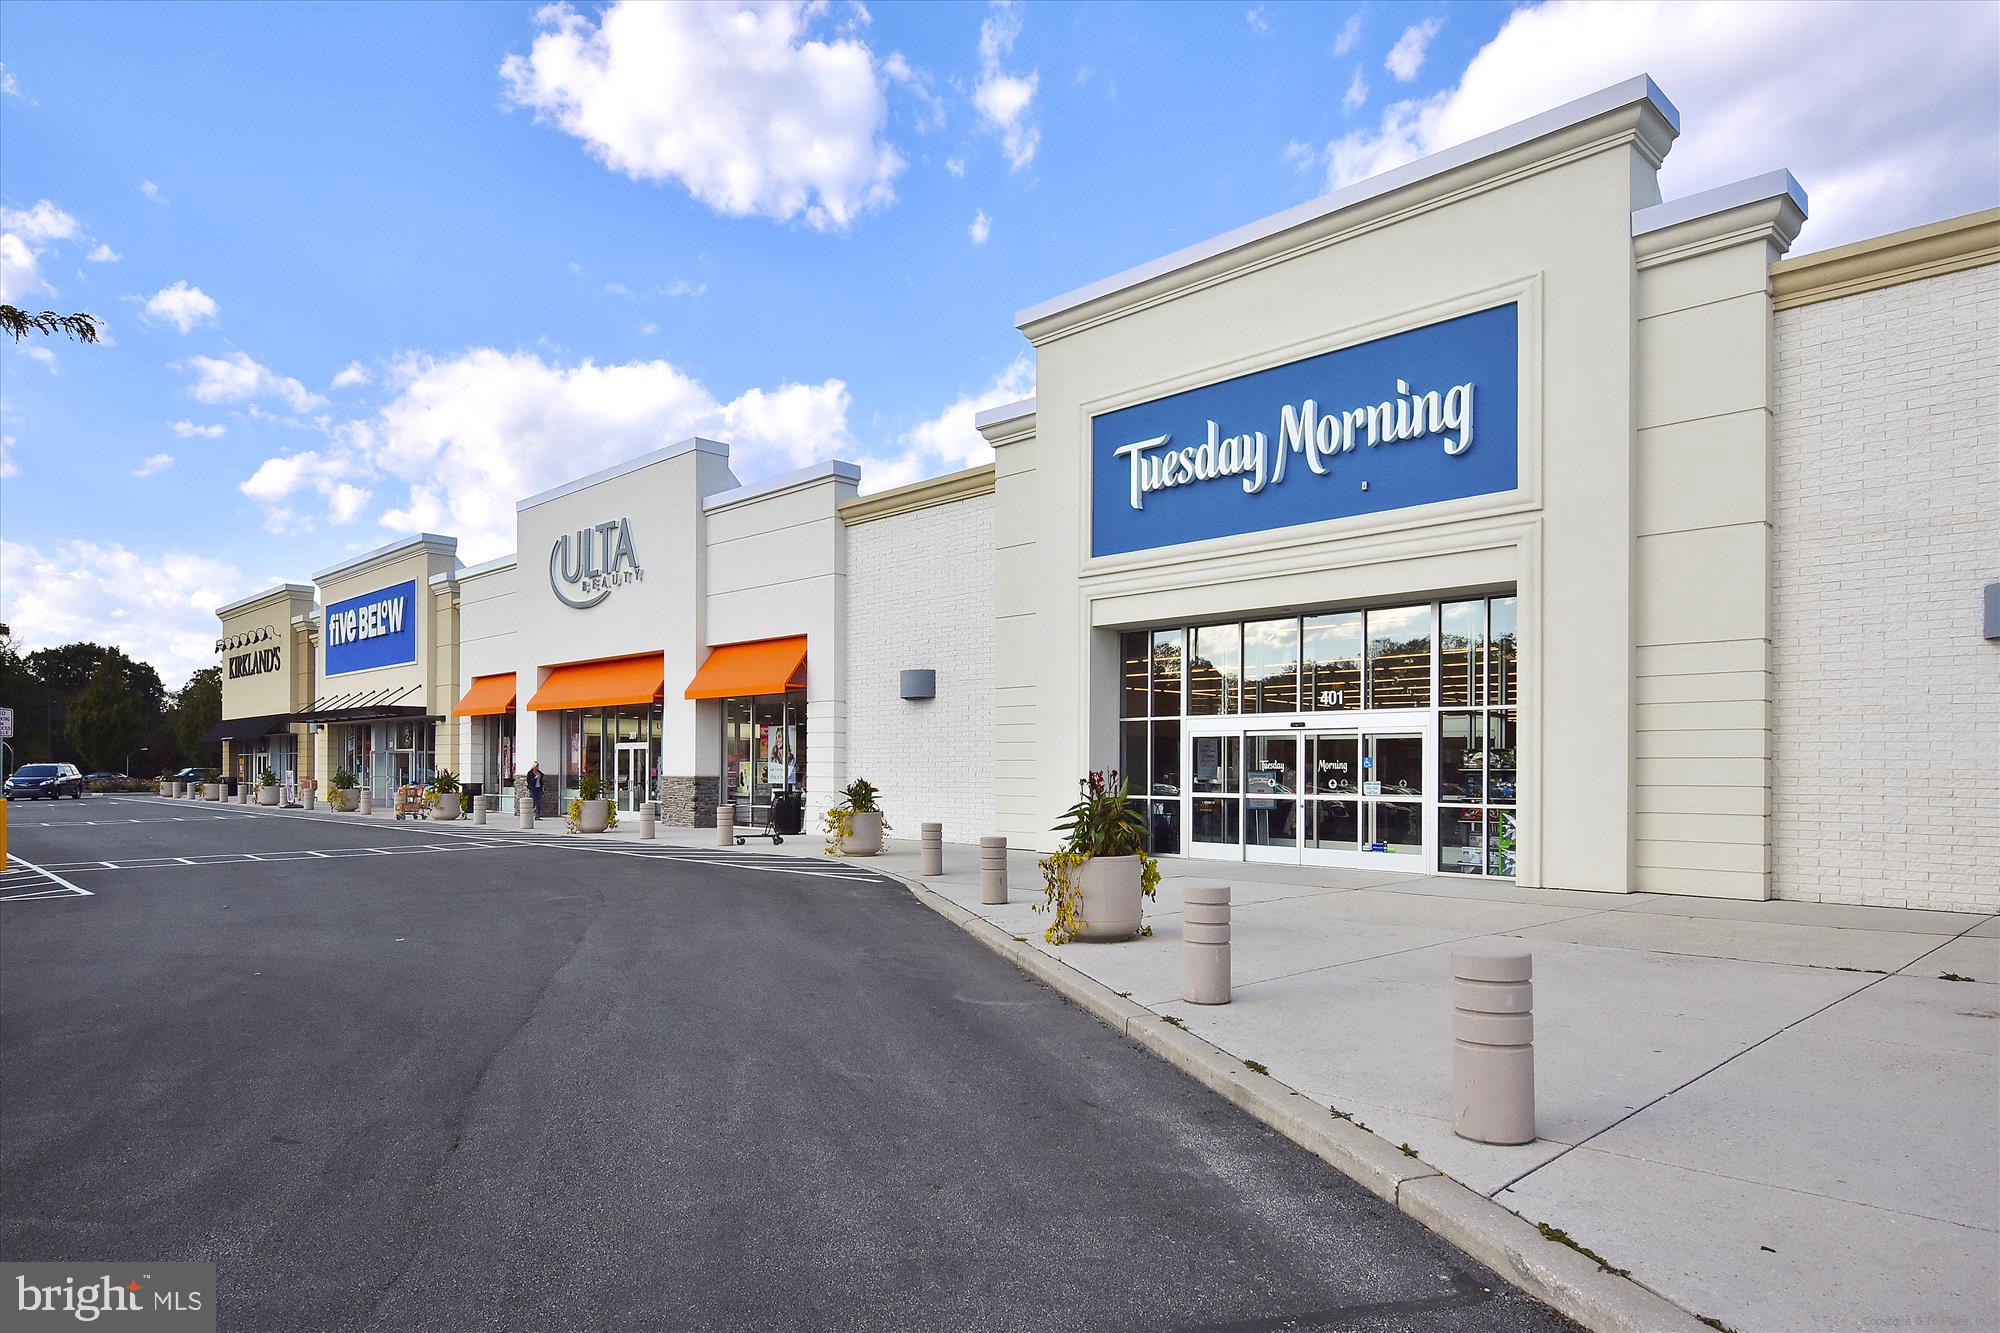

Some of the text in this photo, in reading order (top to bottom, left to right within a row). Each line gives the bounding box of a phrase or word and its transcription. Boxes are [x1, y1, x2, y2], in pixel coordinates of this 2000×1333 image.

[1113, 378, 1476, 510] Tuesday Morning
[560, 517, 640, 583] ULTA
[581, 568, 643, 593] BEAUTY
[329, 608, 357, 646] five
[228, 645, 281, 679] KIRKLAND'S
[1319, 689, 1343, 705] 401
[1259, 759, 1348, 774] Tuesday Morning
